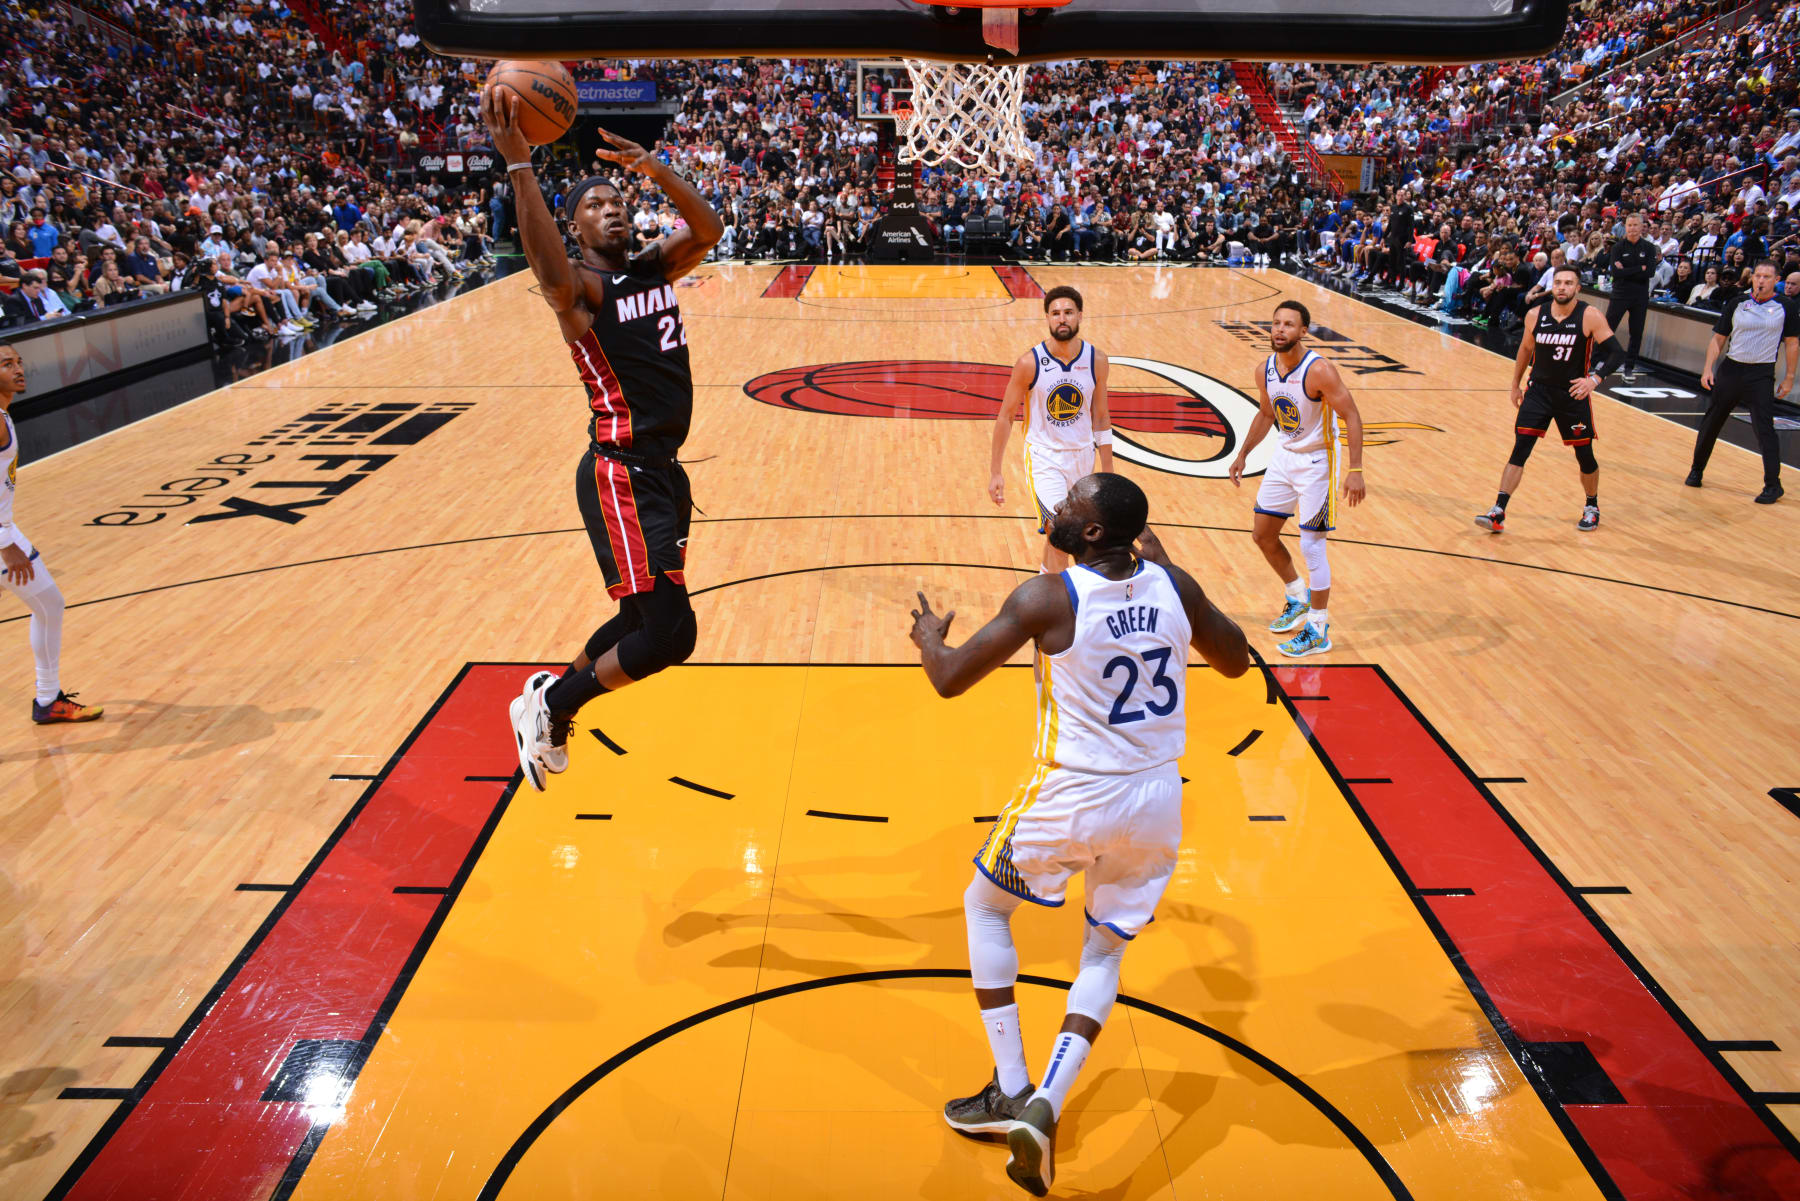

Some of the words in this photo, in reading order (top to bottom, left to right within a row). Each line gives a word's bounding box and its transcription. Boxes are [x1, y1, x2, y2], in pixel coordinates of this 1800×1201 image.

[531, 79, 575, 123] Wilson
[578, 87, 644, 100] etmaster
[419, 155, 446, 169] Bally
[467, 155, 494, 169] Bally
[616, 284, 679, 323] MIAM
[1536, 333, 1577, 345] MIAMI
[1552, 346, 1573, 361] 31
[1046, 378, 1068, 393] GOLDEN
[1070, 379, 1084, 391] STATE
[1071, 392, 1077, 403] 11
[1285, 405, 1297, 418] 30
[1046, 412, 1084, 428] WARRIORS
[82, 453, 276, 526] arena
[185, 454, 399, 525] FTX
[1106, 606, 1159, 639] GREEN
[1102, 646, 1178, 725] 23
